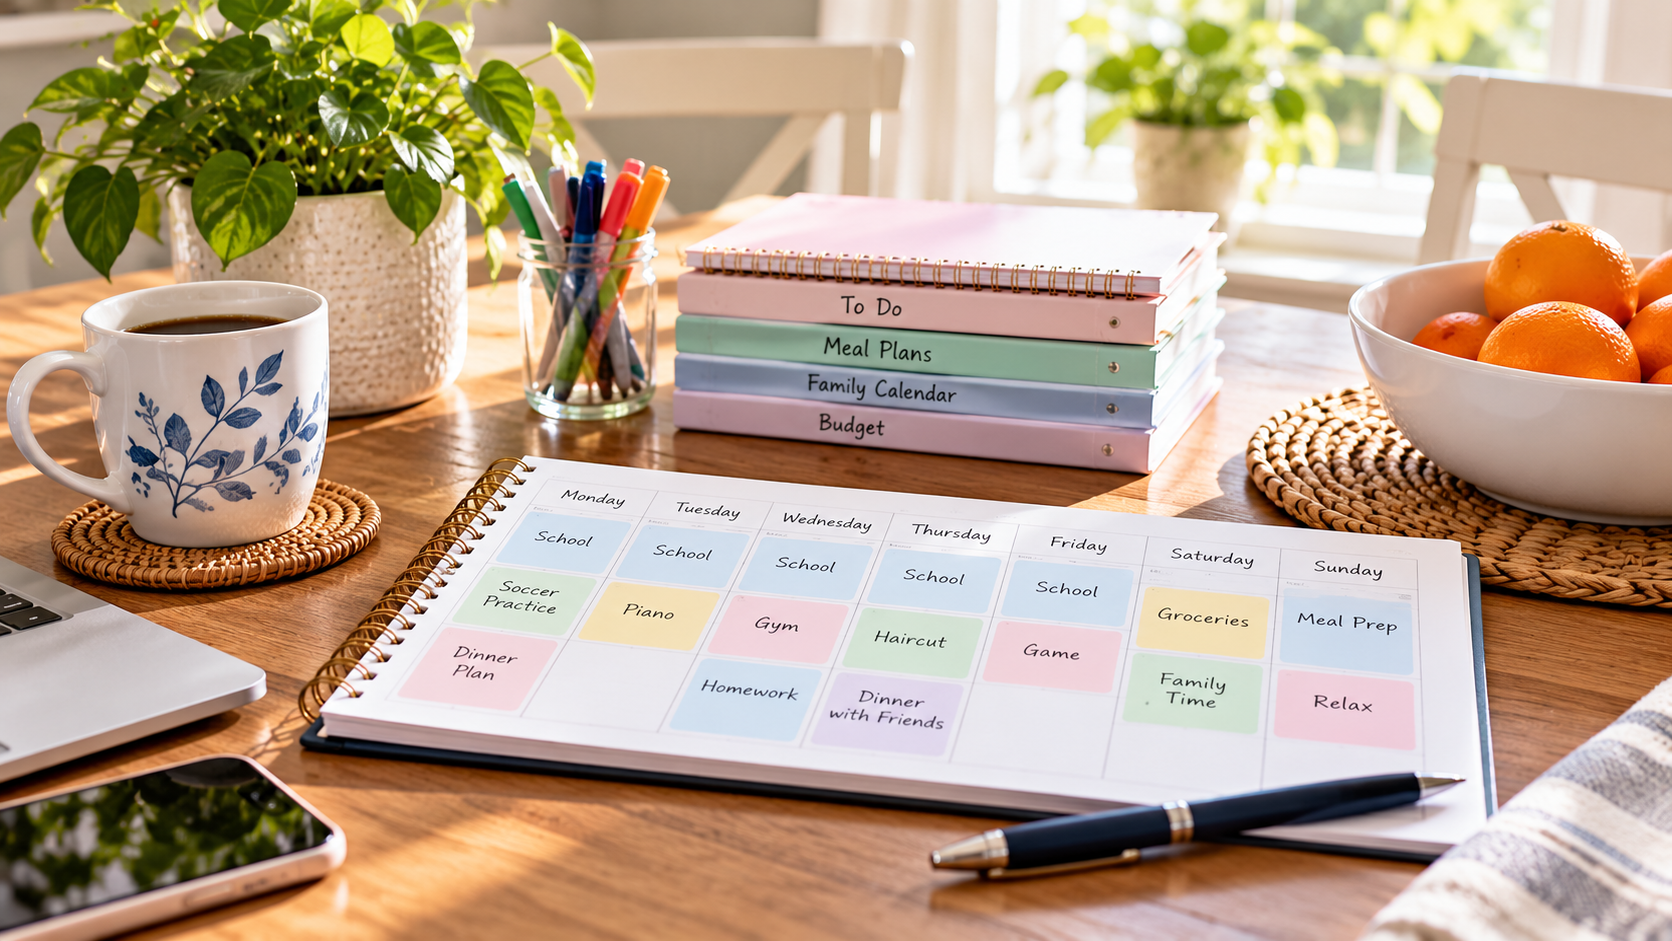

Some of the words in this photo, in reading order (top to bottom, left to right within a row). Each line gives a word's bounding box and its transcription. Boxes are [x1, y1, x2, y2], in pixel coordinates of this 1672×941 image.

[840, 295, 865, 315] To
[876, 297, 902, 317] Do
[823, 336, 869, 358] Meal
[879, 339, 932, 363] Plans
[807, 373, 866, 401] Family
[874, 379, 957, 403] Calendar
[819, 413, 885, 441] Budget
[560, 489, 626, 510] Monday
[676, 501, 741, 522] Tuesday
[783, 512, 873, 535] Wednesday
[534, 530, 594, 548] School
[911, 523, 992, 545] Thursday
[652, 544, 713, 561] School
[1050, 536, 1108, 556] Friday
[775, 556, 837, 573] School
[1171, 547, 1254, 570] Saturday
[903, 568, 965, 586] School
[1314, 560, 1383, 582] Sunday
[498, 580, 560, 597] Soccer
[1035, 580, 1098, 598] School
[482, 594, 558, 615] Practice
[622, 603, 675, 620] Piano
[754, 616, 799, 634] Gym
[1157, 607, 1249, 628] Groceries
[1297, 612, 1343, 628] Meal
[1353, 616, 1398, 636] Prep
[874, 630, 947, 649] Haircut
[453, 645, 518, 664] Dinner
[1023, 643, 1080, 661] Game
[452, 664, 495, 681] Plan
[700, 679, 799, 701] Homework
[1159, 672, 1227, 695] Family
[858, 689, 925, 708] Dinner
[1165, 691, 1217, 709] Time
[1314, 694, 1373, 713] Relax
[829, 708, 869, 722] with
[877, 710, 944, 730] Friends
